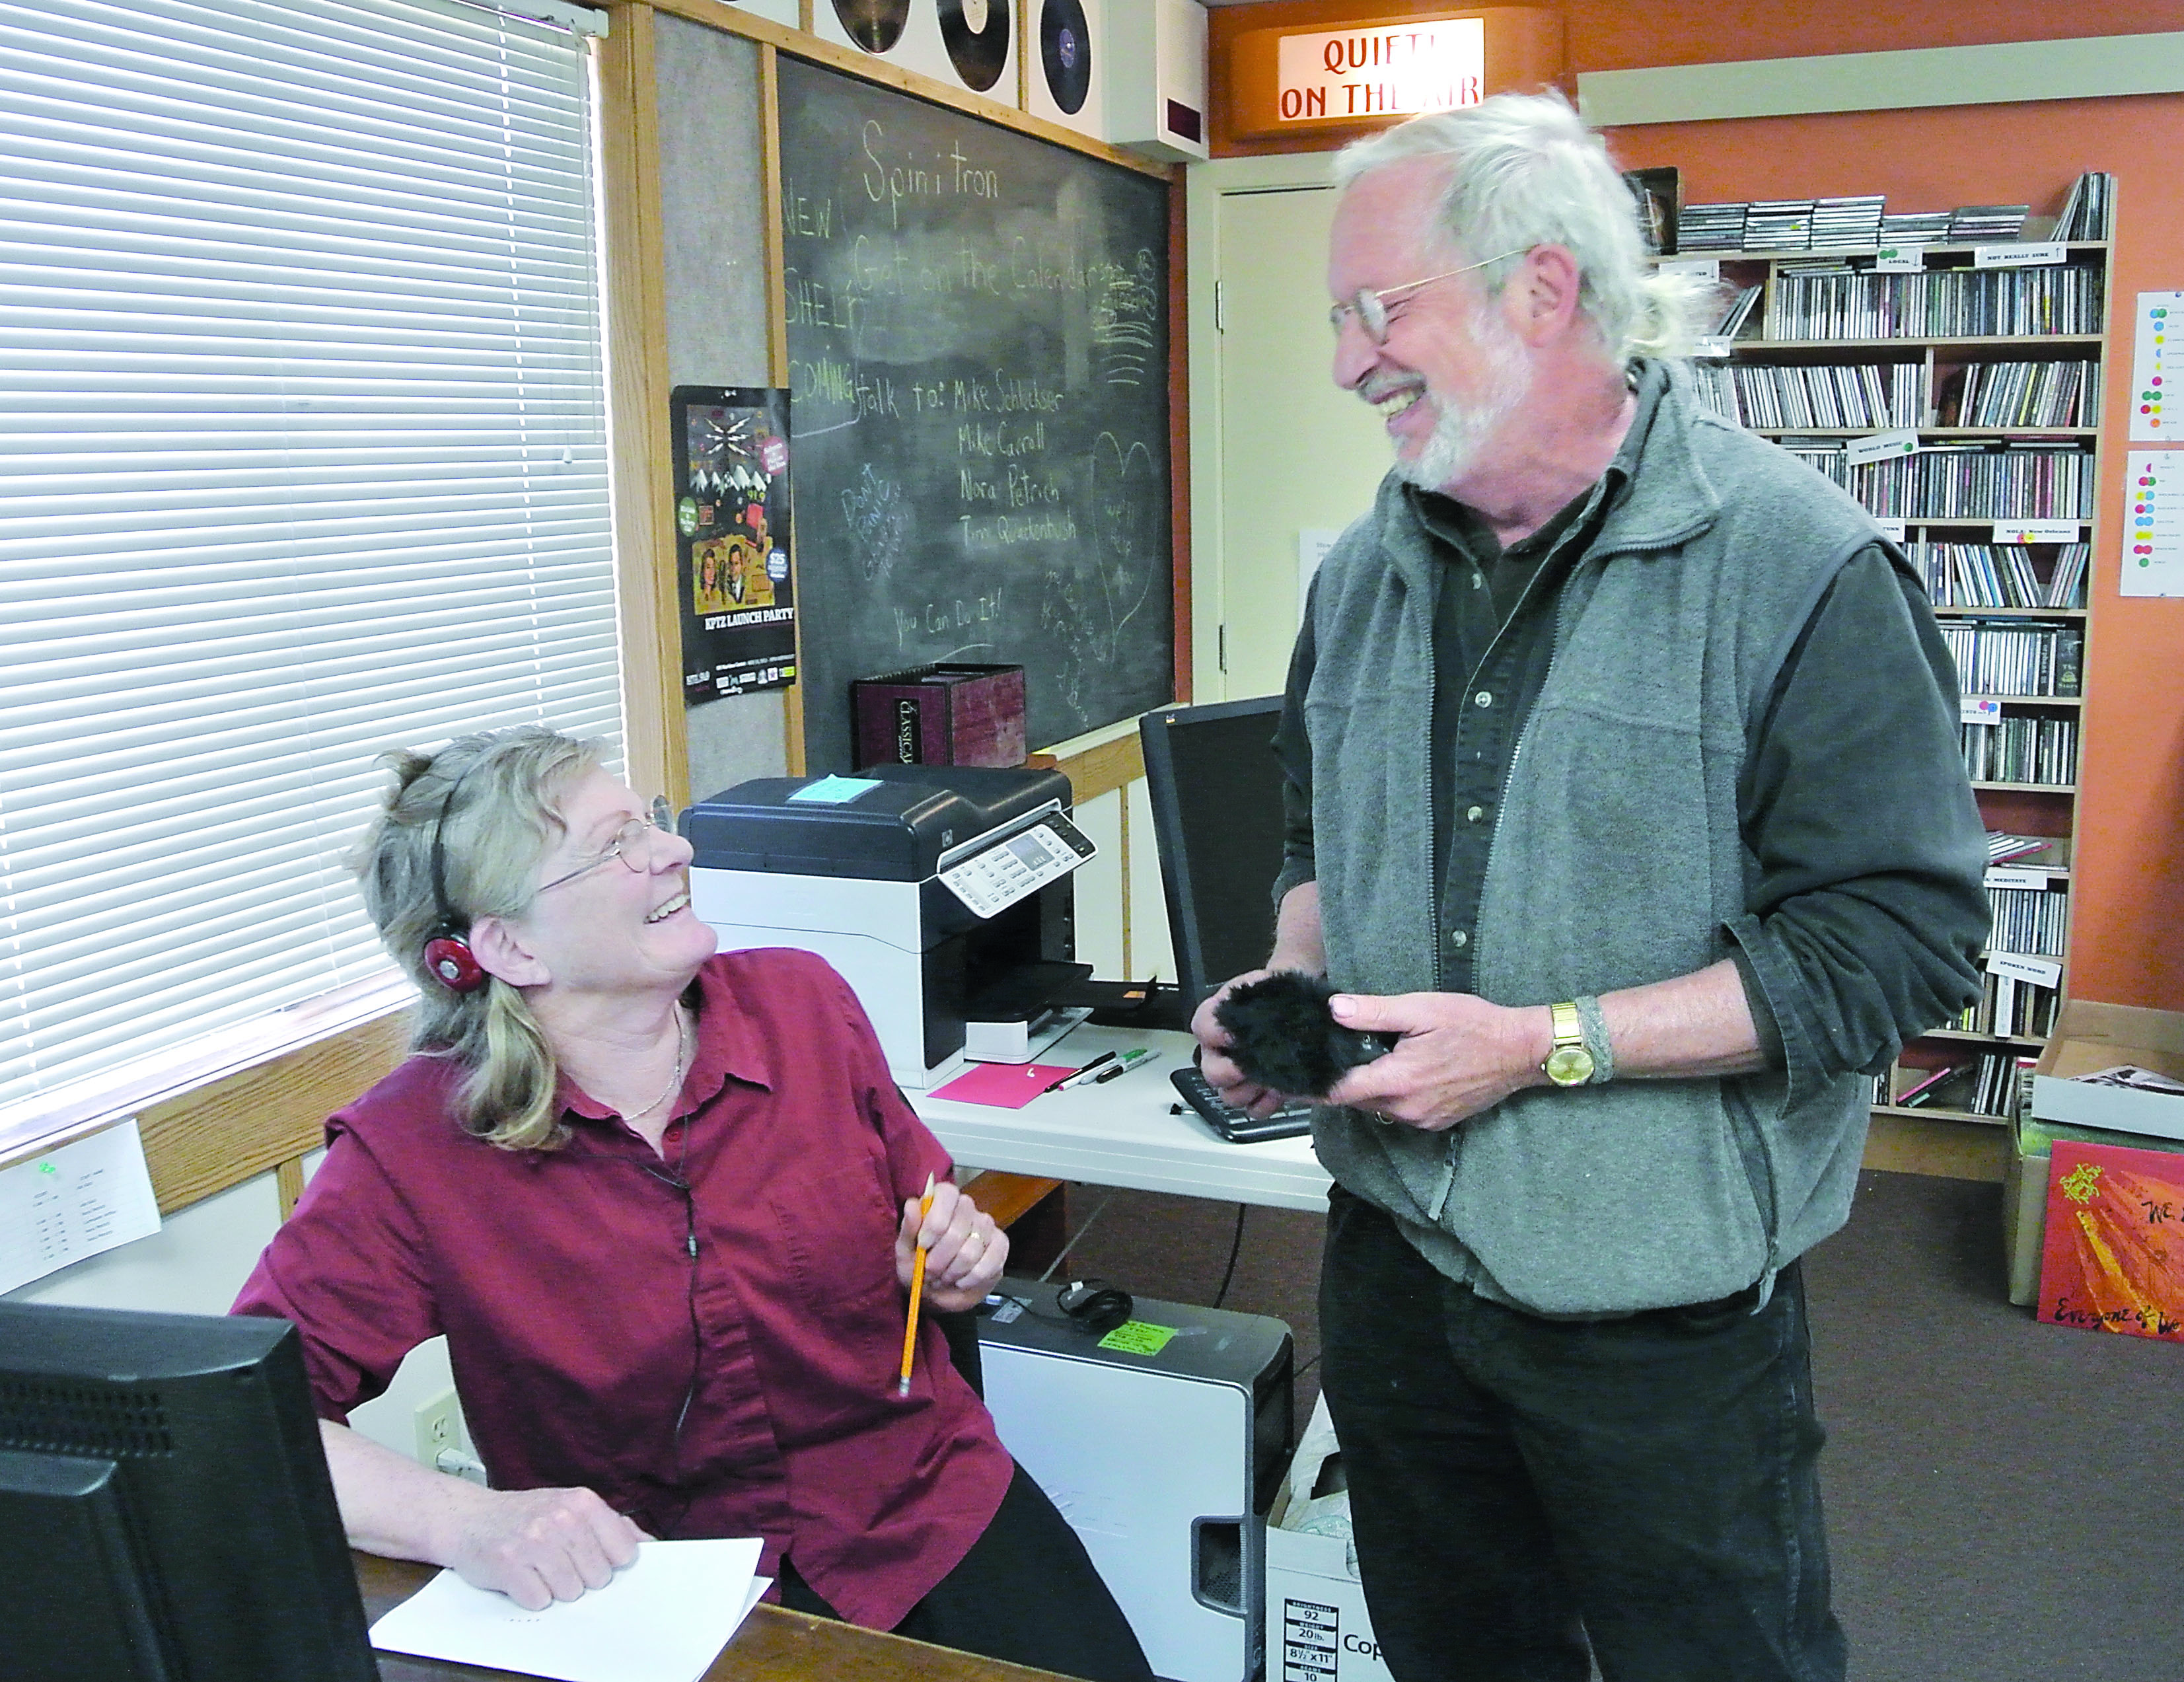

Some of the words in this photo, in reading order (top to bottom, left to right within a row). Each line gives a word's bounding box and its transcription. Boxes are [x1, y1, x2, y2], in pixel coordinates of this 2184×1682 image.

[1281, 87, 1326, 119] ON
[862, 120, 999, 229] Spinitron
[783, 177, 831, 238] NEW
[954, 377, 991, 412] Mike
[959, 422, 993, 456] Mike
[996, 420, 1044, 457] Carroll
[961, 467, 997, 501] Nora
[727, 611, 762, 628] LAUNCH
[763, 607, 793, 622] PARTY
[926, 603, 949, 633] Can
[955, 599, 971, 626] Do
[1304, 1610, 1319, 1621] 92
[1299, 1628, 1313, 1638] 20
[1314, 1632, 1325, 1642] lb.
[1304, 1673, 1317, 1682] 10
